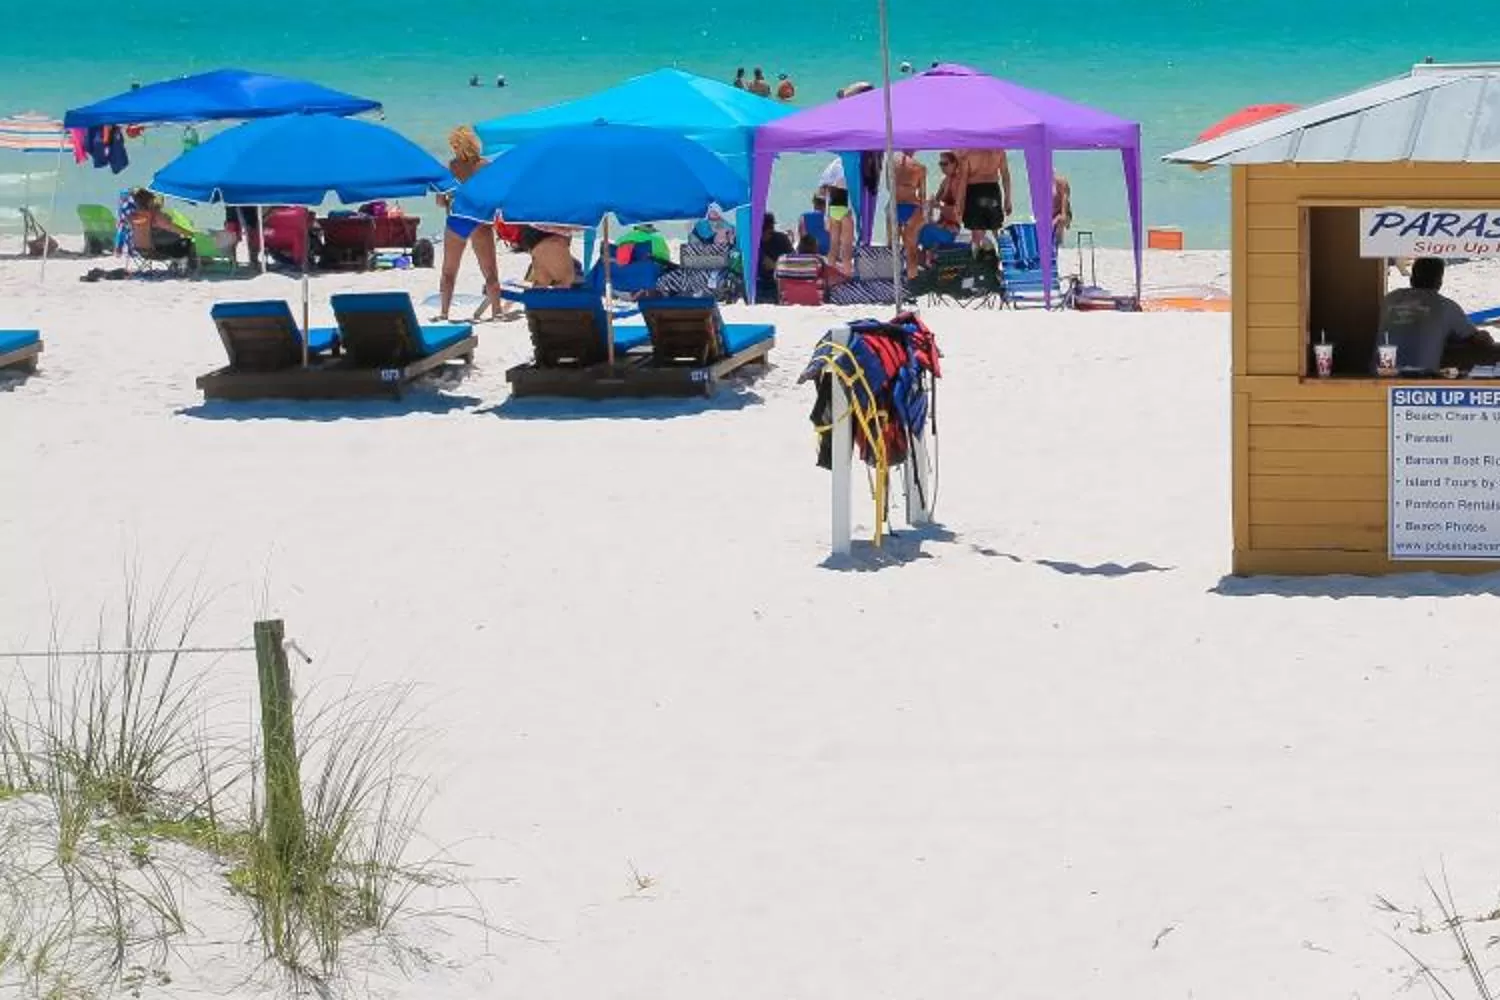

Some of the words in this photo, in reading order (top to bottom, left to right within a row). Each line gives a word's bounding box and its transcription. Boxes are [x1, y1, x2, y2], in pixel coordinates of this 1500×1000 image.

[1413, 241, 1456, 253] Sign
[1463, 242, 1489, 255] Up
[1395, 391, 1436, 405] SIGN
[1442, 391, 1465, 405] UP
[1405, 410, 1441, 421] Beach
[1445, 411, 1477, 421] Chair
[1405, 433, 1453, 443] Parasail
[1405, 456, 1449, 466] Banana
[1453, 456, 1480, 466] Boat
[1405, 478, 1441, 487] Island
[1445, 478, 1478, 488] Tours
[1481, 478, 1495, 490] by
[1405, 500, 1454, 510] Pontoon
[1405, 522, 1441, 532] Beach
[1445, 522, 1487, 533] Photos
